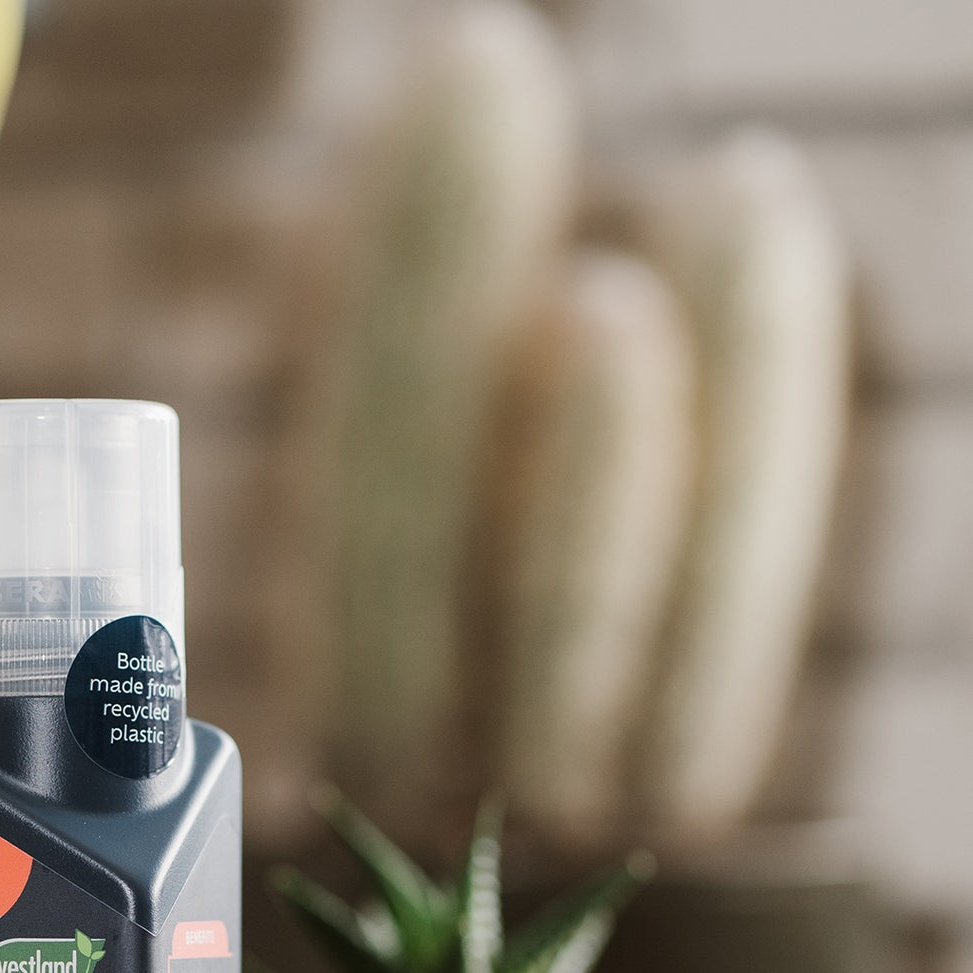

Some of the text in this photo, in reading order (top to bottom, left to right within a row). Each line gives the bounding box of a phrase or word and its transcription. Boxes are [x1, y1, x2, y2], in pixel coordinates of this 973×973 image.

[117, 652, 164, 673] Bottle
[89, 676, 178, 700] made from
[103, 702, 170, 722] recycled
[110, 724, 164, 744] plastic
